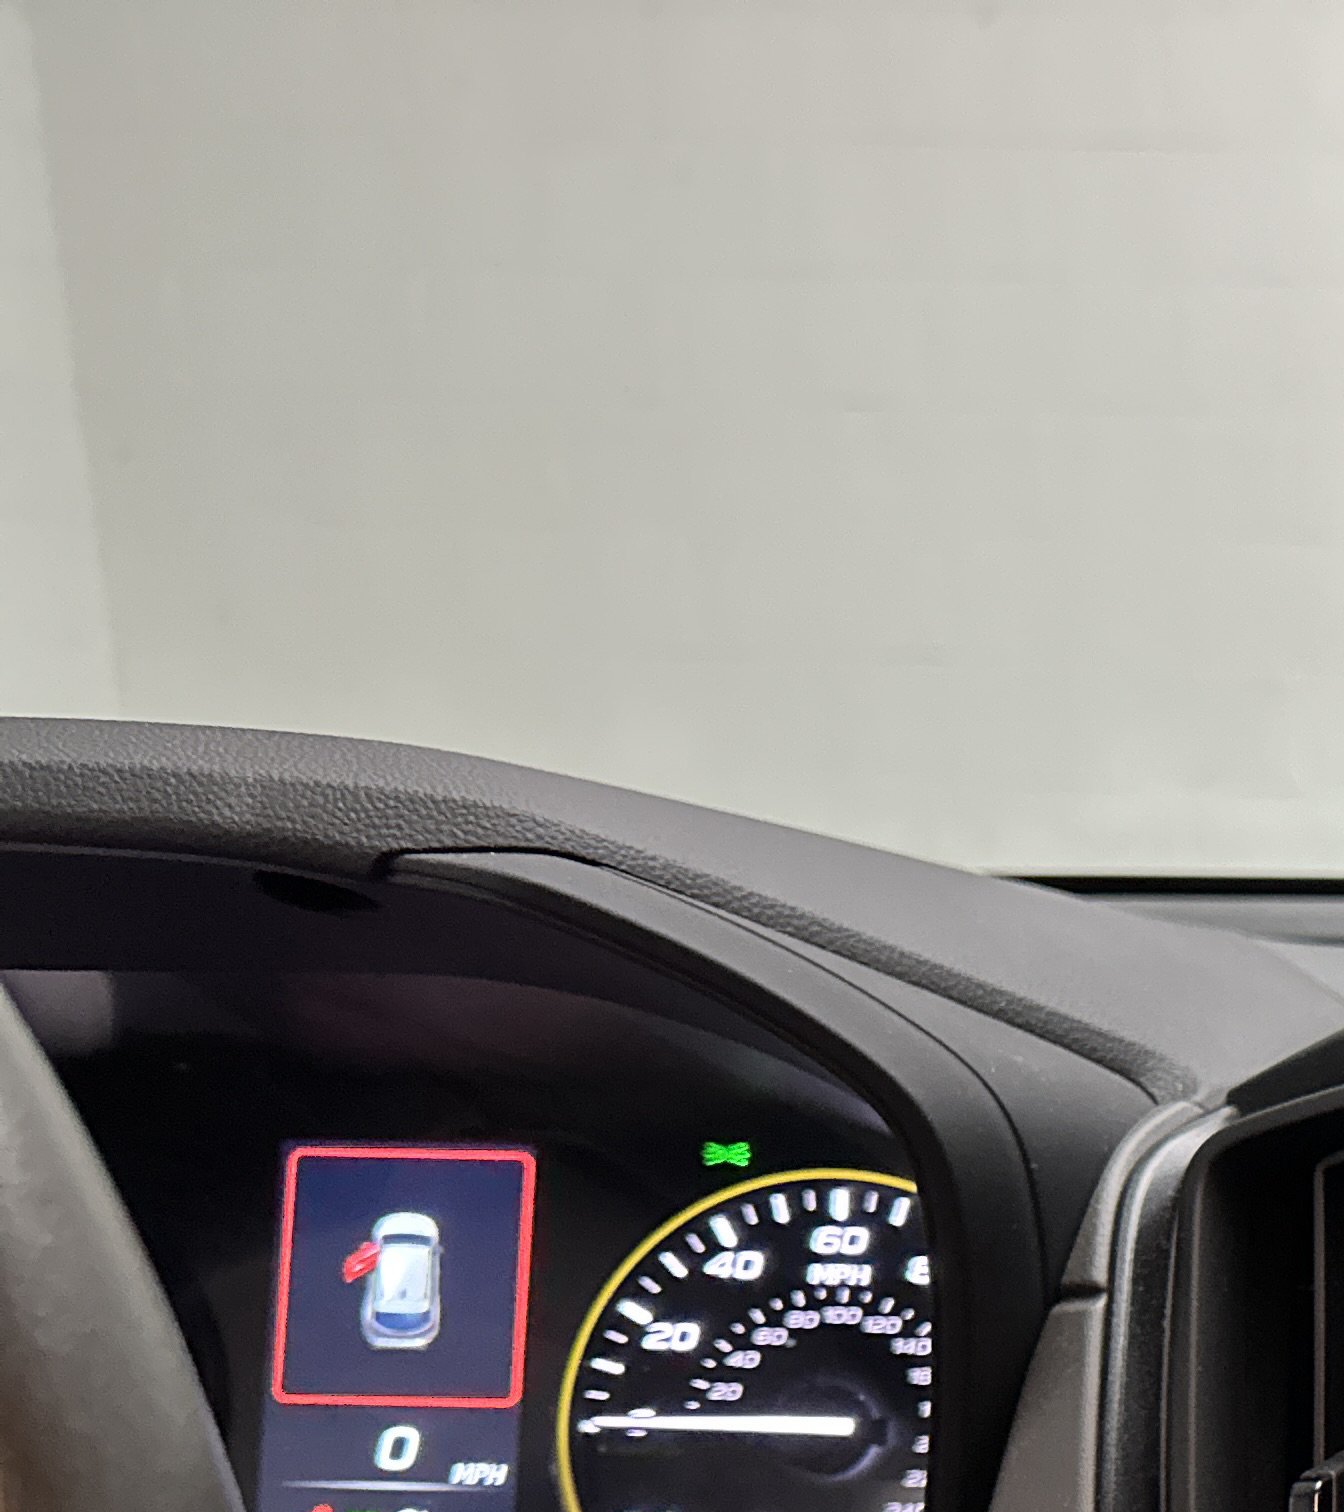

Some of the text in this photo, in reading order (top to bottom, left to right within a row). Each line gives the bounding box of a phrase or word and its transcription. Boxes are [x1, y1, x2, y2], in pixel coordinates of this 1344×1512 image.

[809, 1225, 871, 1256] 60
[703, 1250, 765, 1281] 40
[806, 1263, 873, 1287] MPH
[817, 1305, 865, 1326] 100
[641, 1320, 701, 1352] 20
[721, 1348, 762, 1369] 40
[374, 1425, 422, 1472] 0
[450, 1462, 509, 1486] MPH
